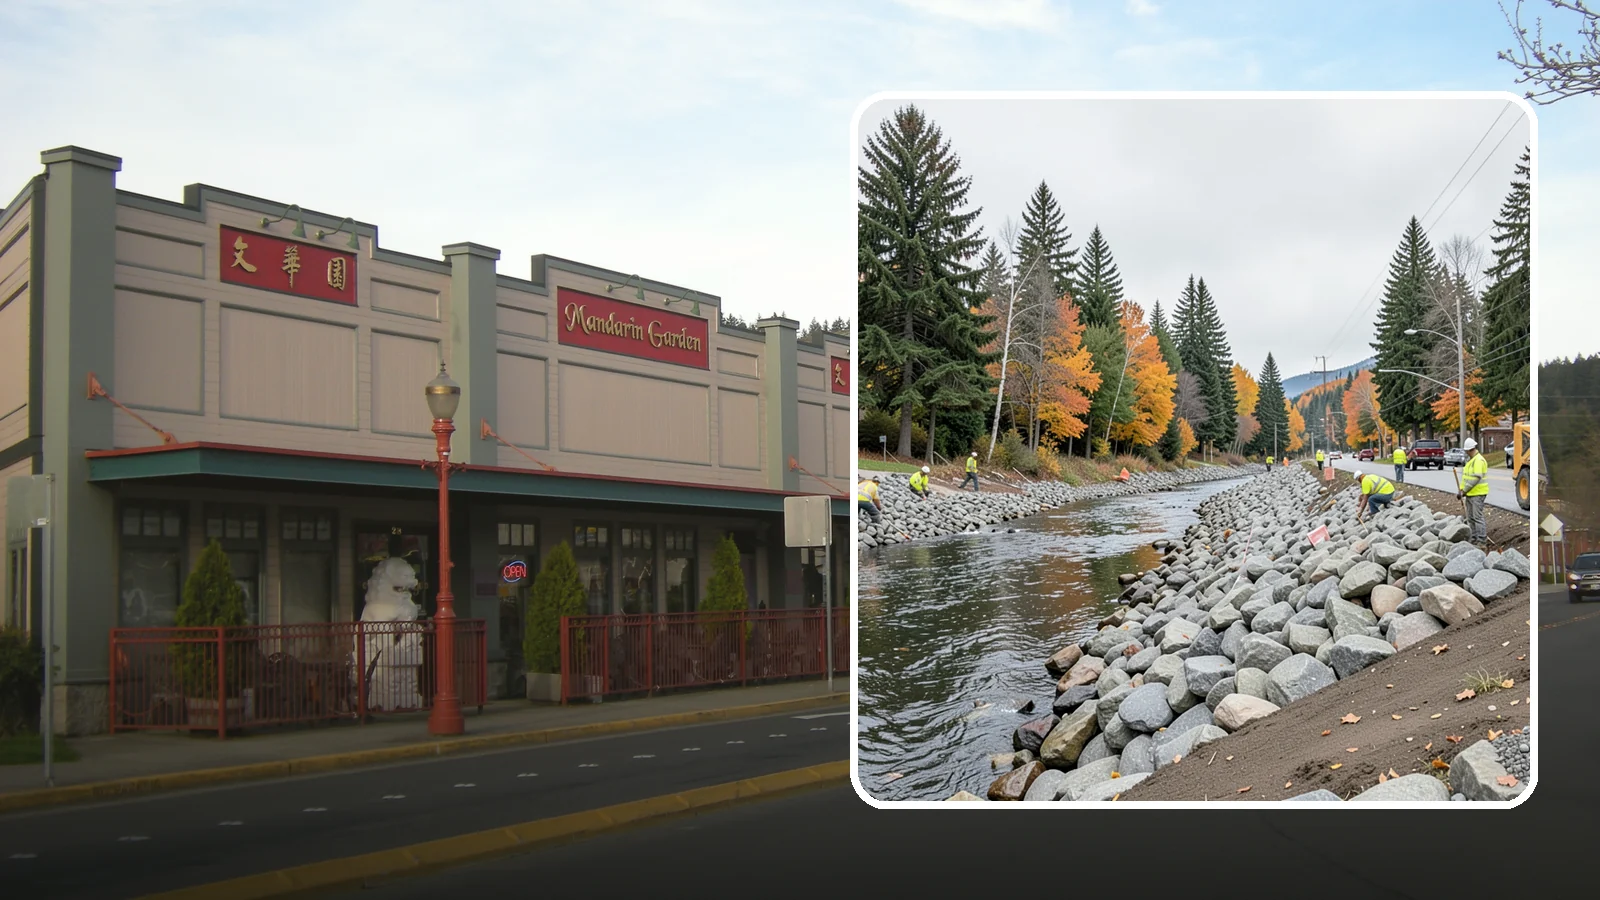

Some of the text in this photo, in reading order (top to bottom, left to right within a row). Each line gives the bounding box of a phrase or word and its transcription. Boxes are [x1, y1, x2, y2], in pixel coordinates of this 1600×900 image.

[230, 235, 346, 291] 文華園
[564, 302, 701, 352] Mandarin Garden
[503, 565, 527, 578] OPEN
